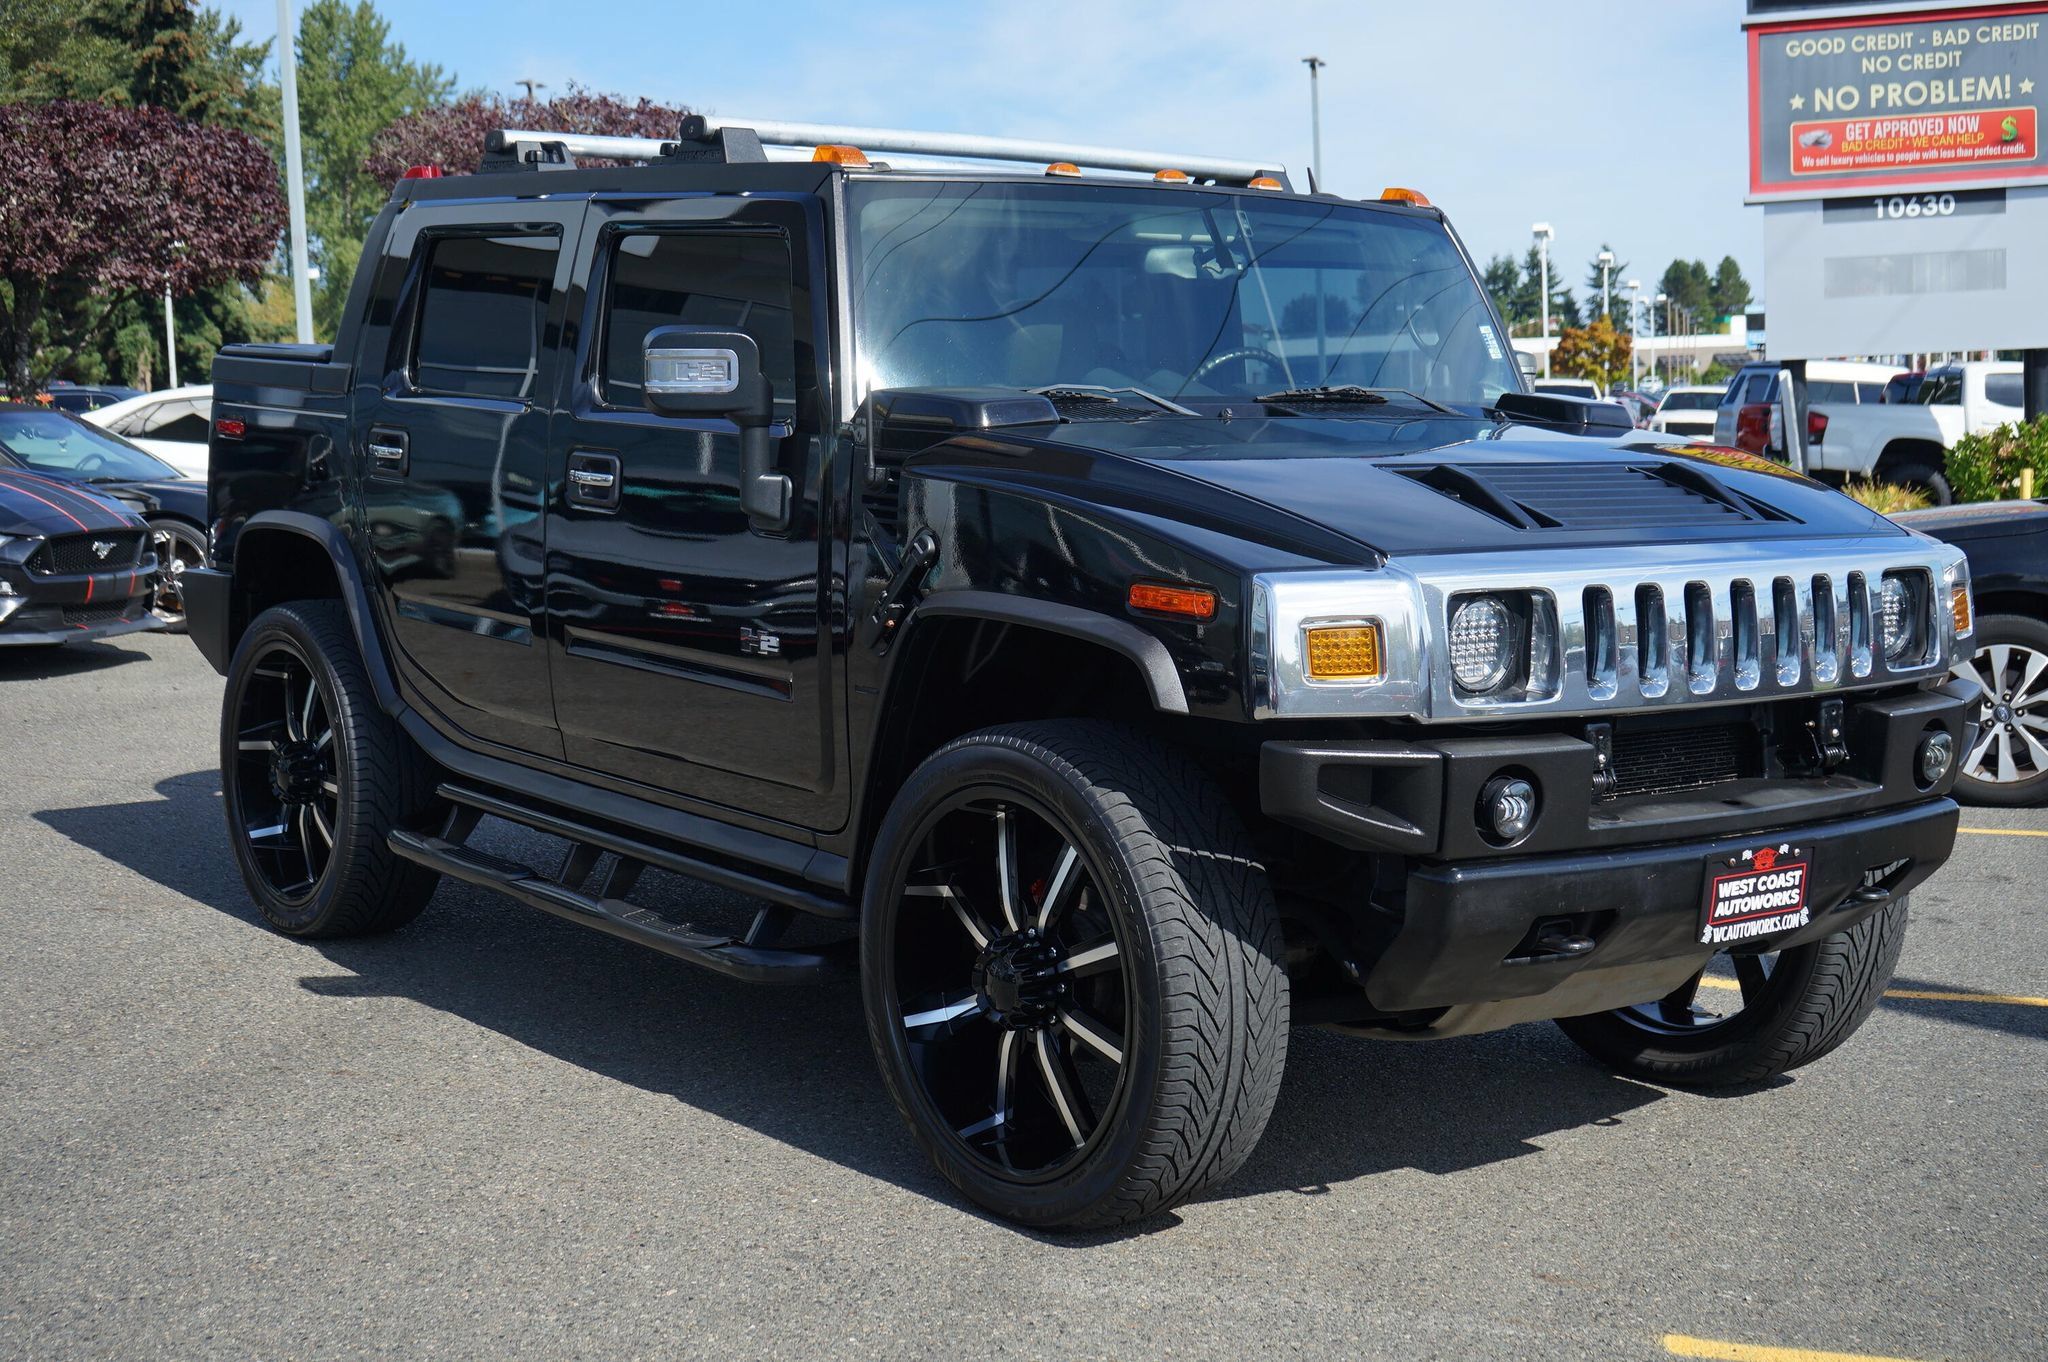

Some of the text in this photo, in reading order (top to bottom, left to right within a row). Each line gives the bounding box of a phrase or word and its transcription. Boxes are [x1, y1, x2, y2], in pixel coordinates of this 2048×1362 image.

[1785, 37, 1846, 58] GOOD
[1851, 31, 1914, 53] CREDIT
[1932, 28, 1971, 47] BAD
[1976, 22, 2040, 44] CREDIT
[1862, 50, 1962, 74] NO CREDIT
[1814, 74, 2011, 113] NO PROBLEM!
[1846, 115, 1980, 141] GET APPROVED NOW
[1802, 156, 1815, 168] We
[1816, 154, 1830, 166] sell
[1831, 152, 1854, 167] luxury
[1855, 150, 1885, 163] vehicles
[1886, 151, 1895, 162] to
[1896, 149, 1921, 164] people
[1922, 147, 1939, 160] with
[1940, 146, 1956, 159] less
[1957, 143, 1973, 157] than
[1974, 143, 2001, 160] perfect
[1841, 140, 1863, 153] BAD
[1865, 138, 1904, 151] CREDIT
[1912, 136, 1929, 148] WE
[1931, 134, 1954, 147] CAN
[1956, 132, 1985, 145] HELP
[1873, 193, 1956, 219] 10630
[1718, 869, 1803, 899] WEST COAST
[1714, 888, 1801, 918] AUTOWORKS
[1712, 913, 1801, 943] WCAUTOWORKS.COM
